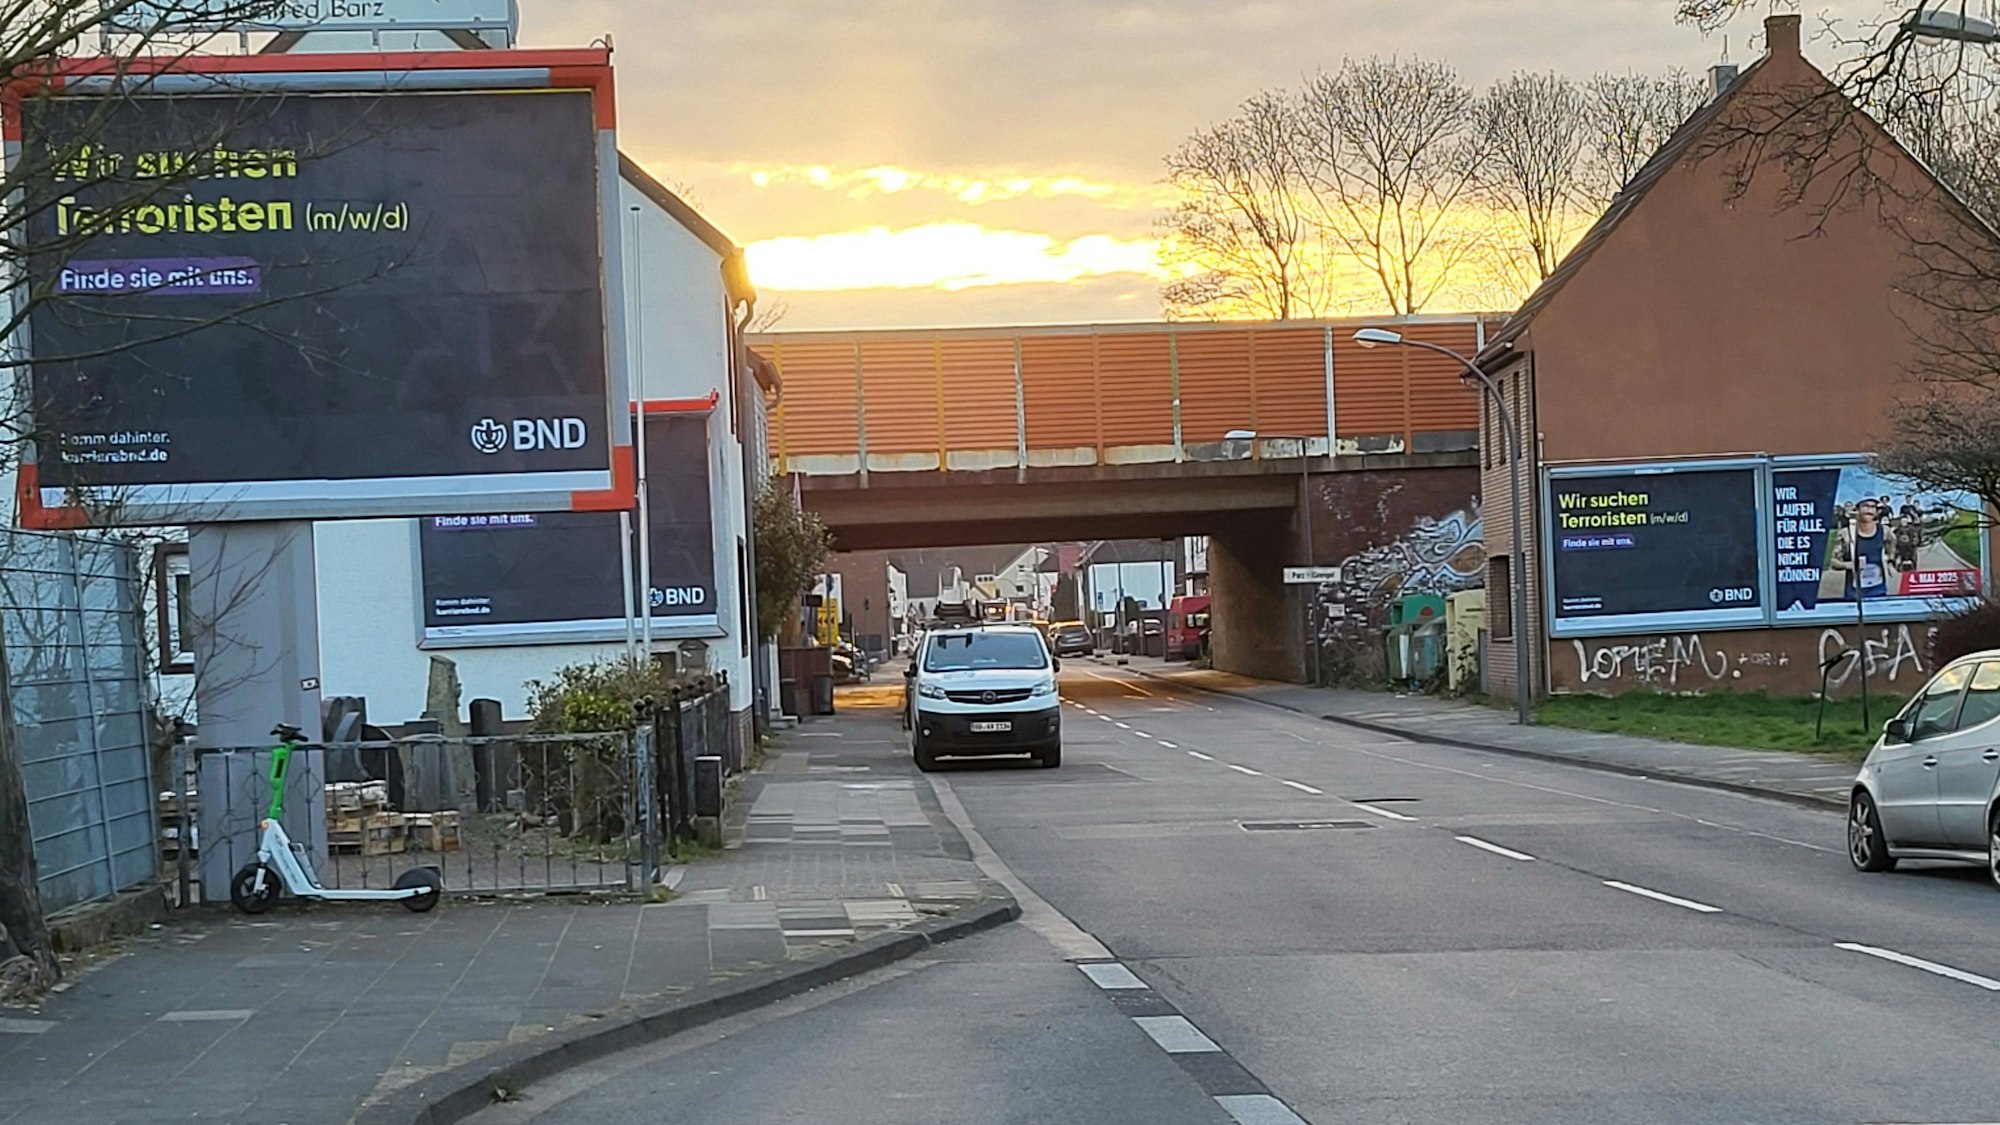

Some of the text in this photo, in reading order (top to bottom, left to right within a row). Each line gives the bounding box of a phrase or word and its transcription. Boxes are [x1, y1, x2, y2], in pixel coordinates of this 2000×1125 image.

[331, 0, 384, 18] Barz
[57, 193, 408, 235] Terroristen (m/w/d)
[61, 266, 254, 290] Finde sie mit uns.
[513, 417, 586, 450] BND
[1558, 491, 1649, 509] Wir suchen
[1775, 487, 1796, 500] WIR
[1776, 503, 1814, 516] LAUFEN
[435, 515, 468, 527] Finde
[470, 515, 487, 525] sie
[489, 514, 508, 525] mit
[1559, 511, 1689, 529] Terroristen (m/w/d)
[1776, 519, 1798, 533] FÜR
[1563, 538, 1587, 548] Finde
[1777, 535, 1811, 549] DIE ES
[1778, 553, 1809, 565] NICHT
[1778, 568, 1819, 582] KÖNNEN
[666, 587, 705, 606] BND
[1725, 588, 1753, 601] BND
